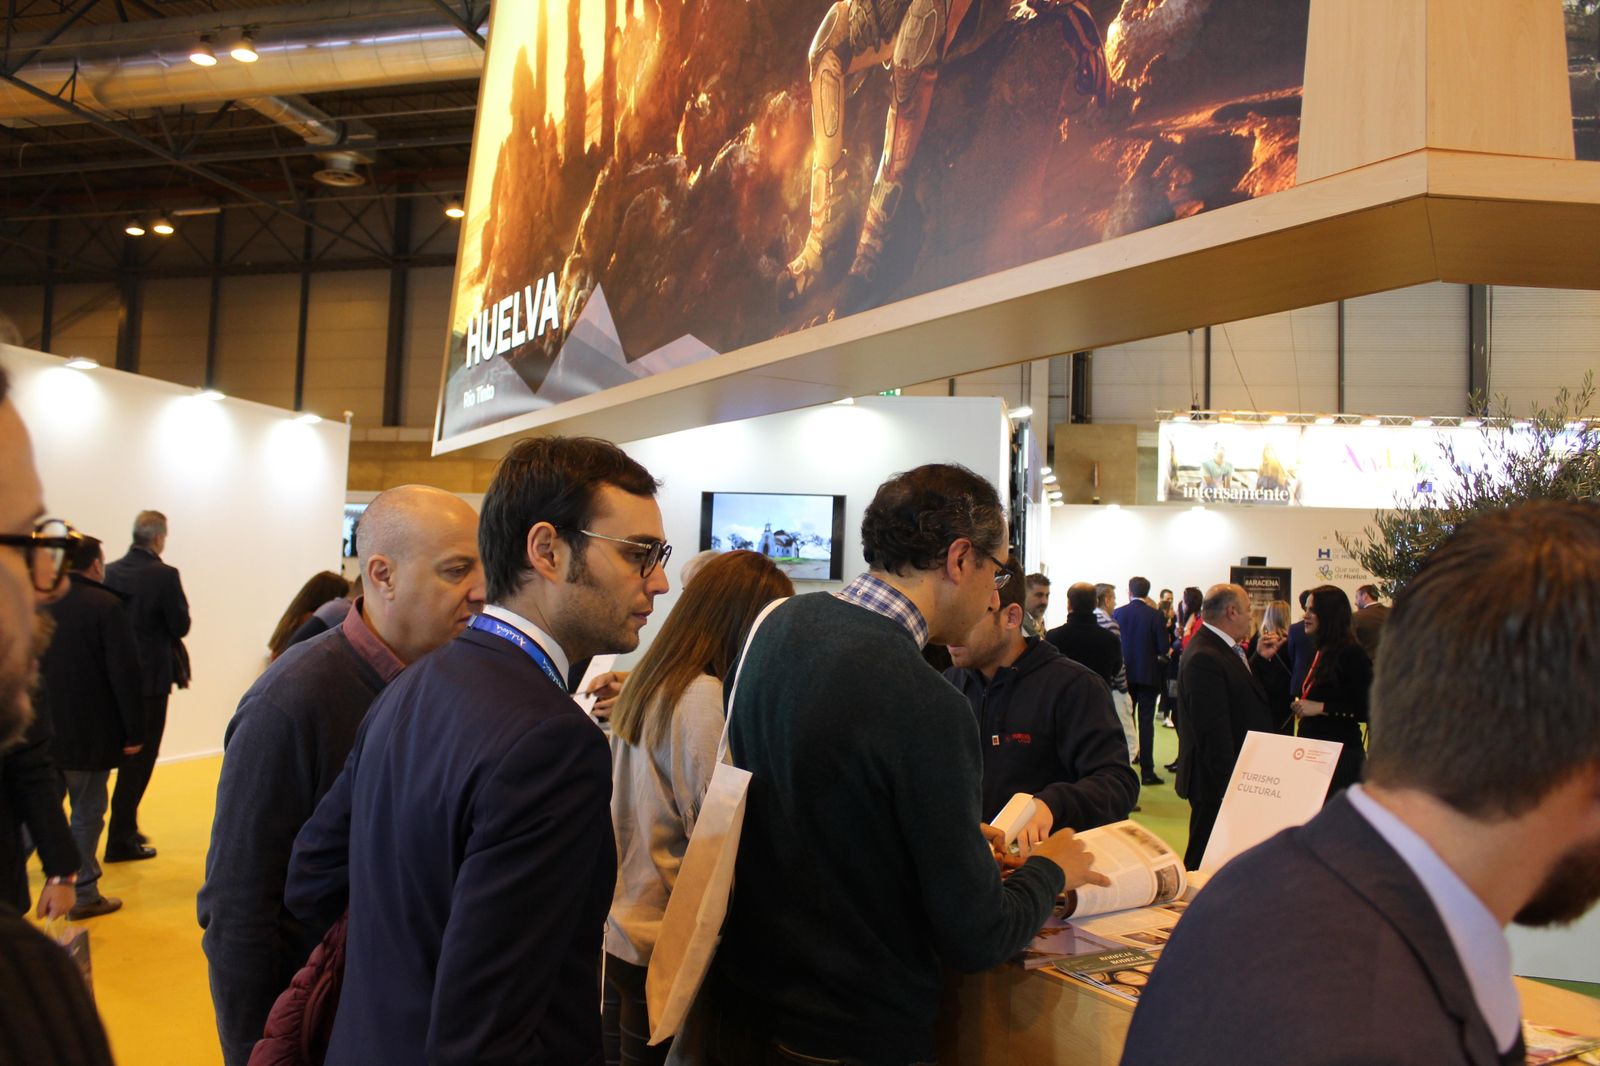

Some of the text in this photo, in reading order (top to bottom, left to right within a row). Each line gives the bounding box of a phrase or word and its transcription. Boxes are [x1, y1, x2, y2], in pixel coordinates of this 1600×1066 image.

[466, 271, 559, 368] HUELVA
[476, 384, 495, 404] Tinto
[1183, 482, 1289, 501] intensamente
[1245, 579, 1279, 587] #ARACENA
[1241, 772, 1281, 786] TURISMO
[1237, 783, 1281, 799] CULTURAL
